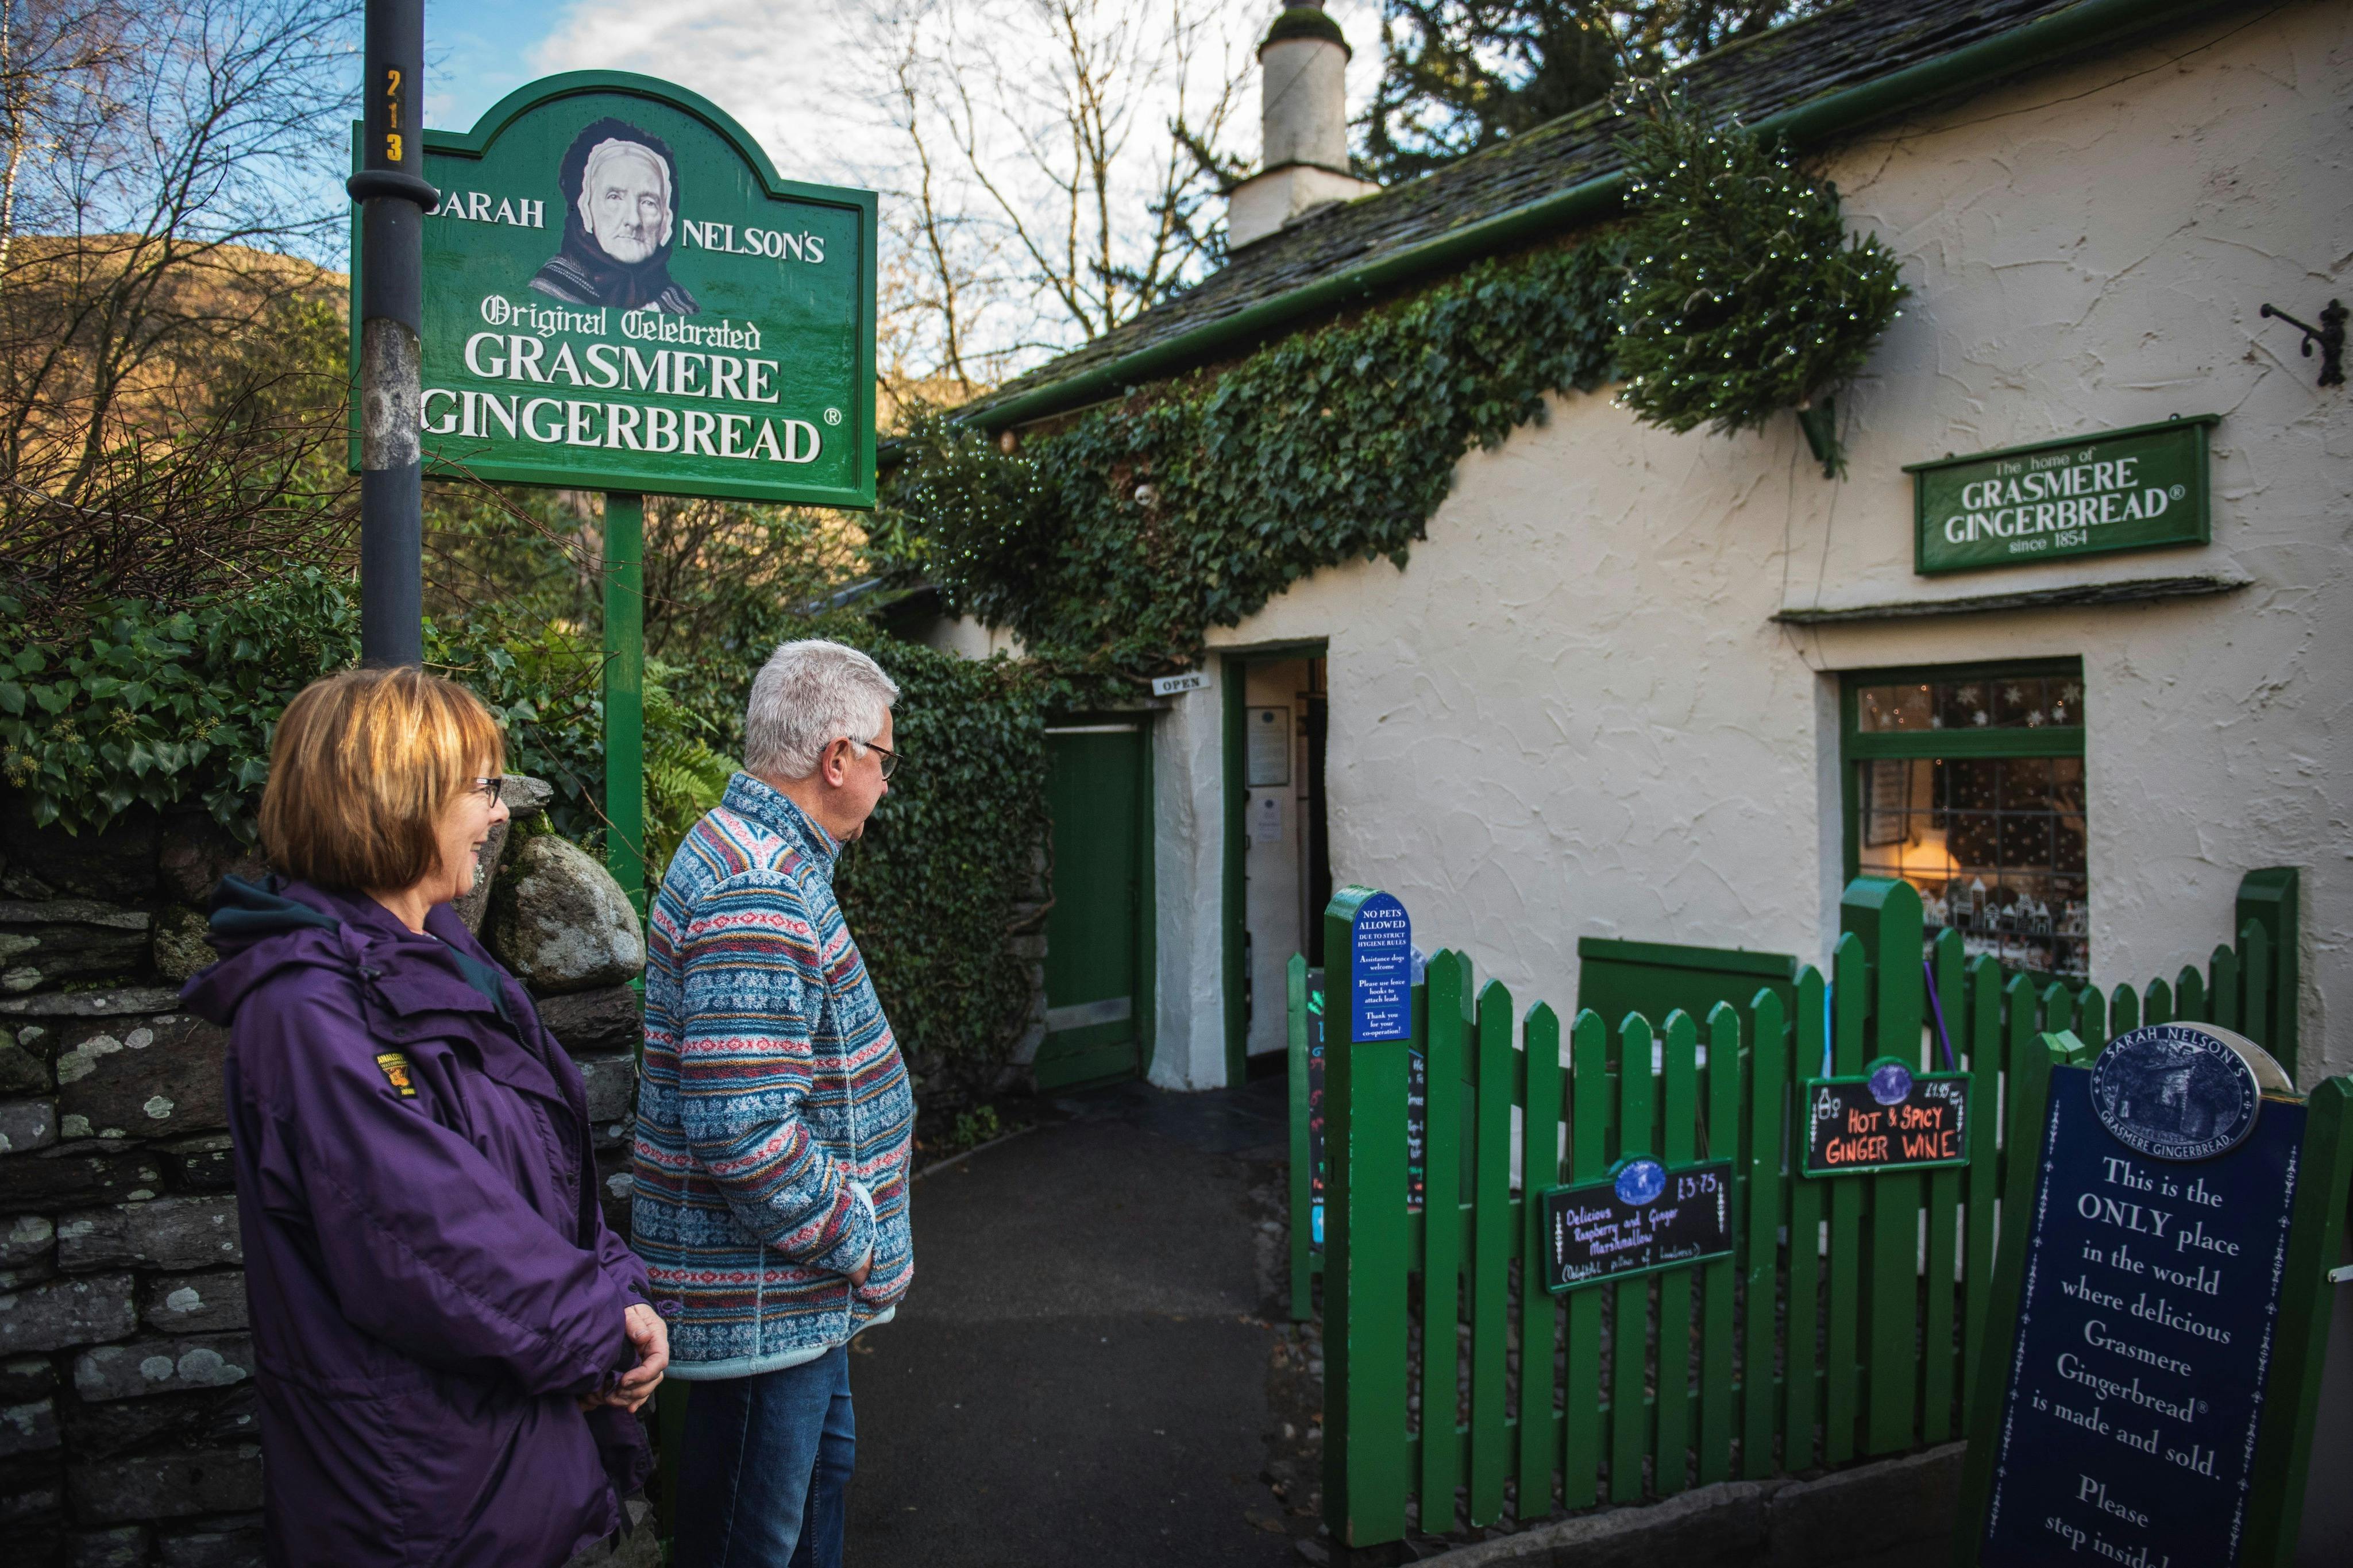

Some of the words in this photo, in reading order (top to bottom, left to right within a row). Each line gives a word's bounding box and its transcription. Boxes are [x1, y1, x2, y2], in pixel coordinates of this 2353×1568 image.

[387, 69, 402, 161] 213
[682, 219, 826, 264] NELSON'S
[481, 294, 607, 337] Original
[621, 310, 762, 352] Celebrated
[465, 332, 780, 404] GRASMERE
[1996, 462, 2022, 476] The
[2031, 452, 2070, 471] home
[2079, 446, 2097, 464] of
[1962, 457, 2139, 511] GRASMERE
[2009, 538, 2047, 554] since
[2054, 530, 2087, 549] 1854
[1163, 677, 1199, 691] OPEN
[1359, 920, 1406, 930] ALLOWED
[1363, 910, 1378, 918] NO
[1380, 909, 1401, 918] PETS
[1391, 954, 1405, 963] dogs
[1364, 995, 1383, 1003] attach
[1370, 987, 1386, 995] hooks
[1363, 1026, 1401, 1038] co-operation!
[1365, 1011, 1386, 1019] Thank
[2106, 1028, 2158, 1059] SARAH
[2168, 1028, 2246, 1077] NELSON'S
[1847, 1106, 1883, 1134] HOT
[1888, 1106, 1897, 1127] &
[1900, 1104, 1943, 1130] SPICY
[2101, 1110, 2149, 1150] GRASMERE
[1826, 1135, 1889, 1164] GINGER
[1901, 1129, 1956, 1159] WINE
[2103, 1156, 2154, 1193] This
[2160, 1175, 2178, 1198] is
[2187, 1178, 2223, 1208] the
[1567, 1206, 1612, 1226] Delicious
[1573, 1223, 1618, 1243] Raspberry
[1623, 1210, 1641, 1228] and
[1648, 1207, 1679, 1231] Ginger
[2077, 1192, 2173, 1237] ONLY
[2176, 1221, 2240, 1257] place
[2082, 1239, 2103, 1262] in
[2111, 1244, 2145, 1275] the
[2151, 1265, 2221, 1296] world
[2061, 1274, 2124, 1311] where
[2130, 1292, 2231, 1345] delicious
[2084, 1319, 2192, 1377] Grasmere
[2032, 1389, 2048, 1411] is
[2054, 1406, 2110, 1435] made
[2116, 1429, 2159, 1455] and
[2165, 1445, 2221, 1481] sold.
[2076, 1474, 2149, 1528] Please
[2045, 1516, 2086, 1552] step
